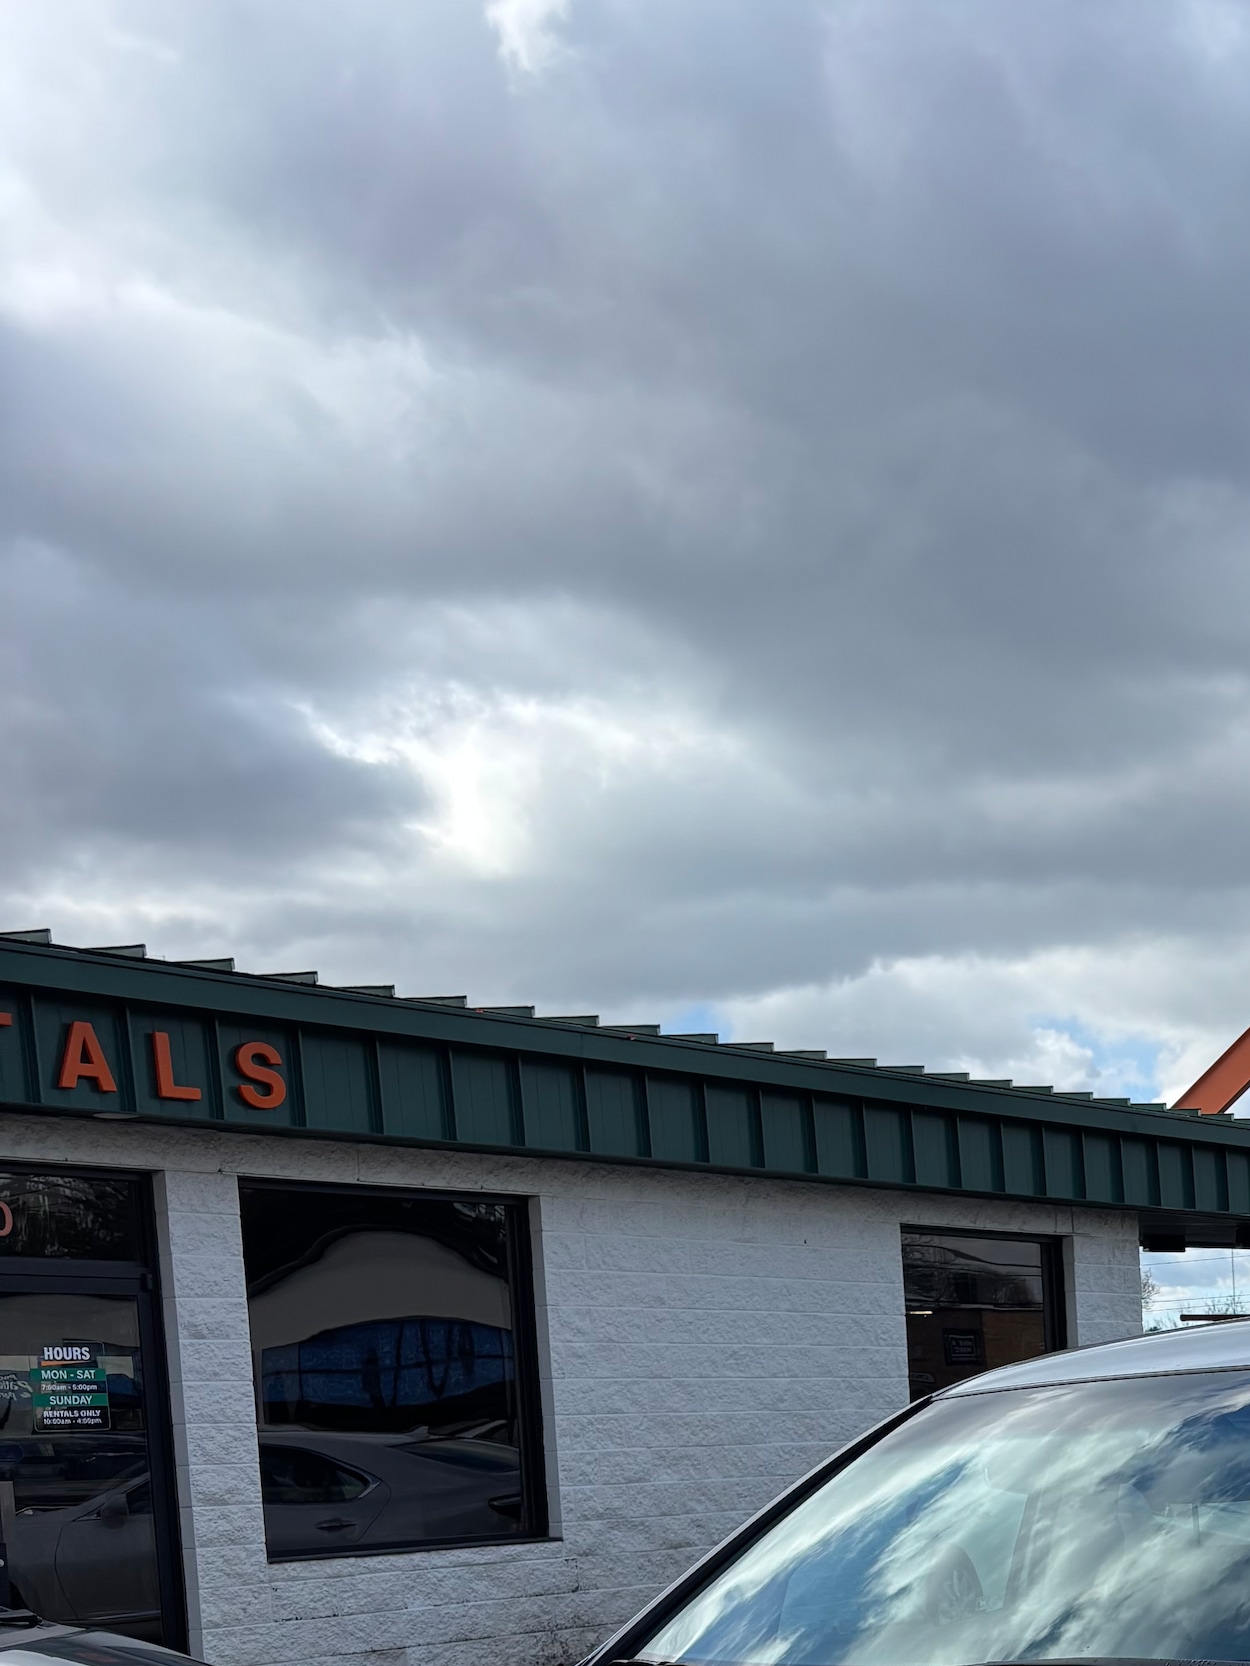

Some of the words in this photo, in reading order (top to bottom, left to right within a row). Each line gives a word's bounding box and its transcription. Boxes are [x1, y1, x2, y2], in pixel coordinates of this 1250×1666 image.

[0, 1012, 287, 1110] ALS
[43, 1346, 91, 1361] HOURS
[41, 1370, 67, 1380] MON
[76, 1370, 96, 1380] SAT
[49, 1395, 93, 1405] SUNDAY
[43, 1410, 79, 1418] RENTALS
[80, 1409, 101, 1417] ONLY
